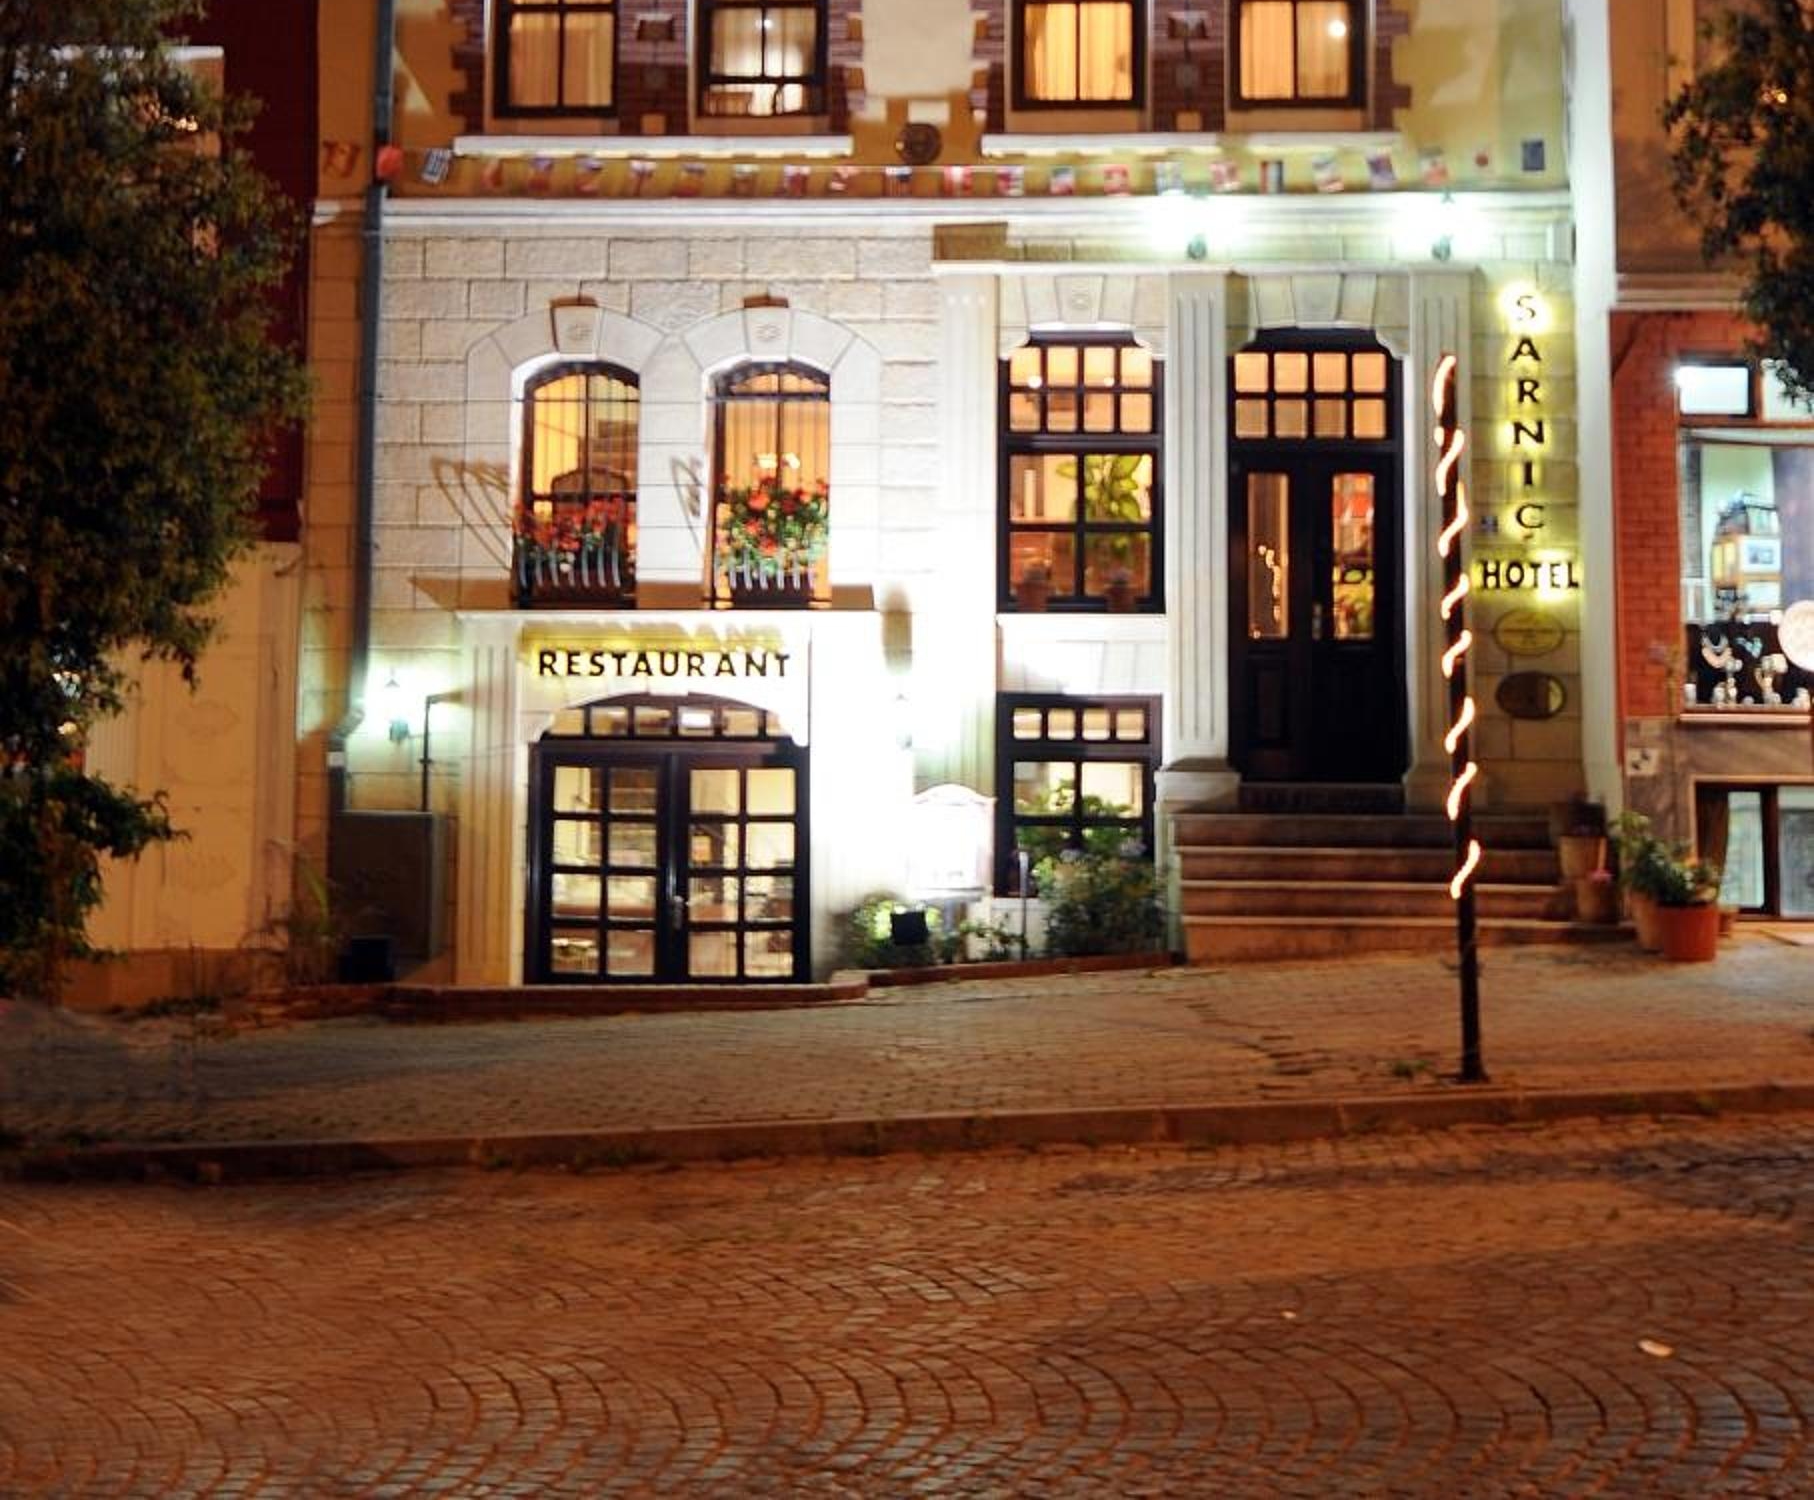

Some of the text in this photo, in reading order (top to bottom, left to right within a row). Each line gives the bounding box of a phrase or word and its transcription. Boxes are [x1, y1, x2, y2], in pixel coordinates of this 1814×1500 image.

[1510, 295, 1546, 539] SARNIÇ
[1481, 560, 1580, 589] HOTEL
[538, 649, 791, 677] RESTAURANT
